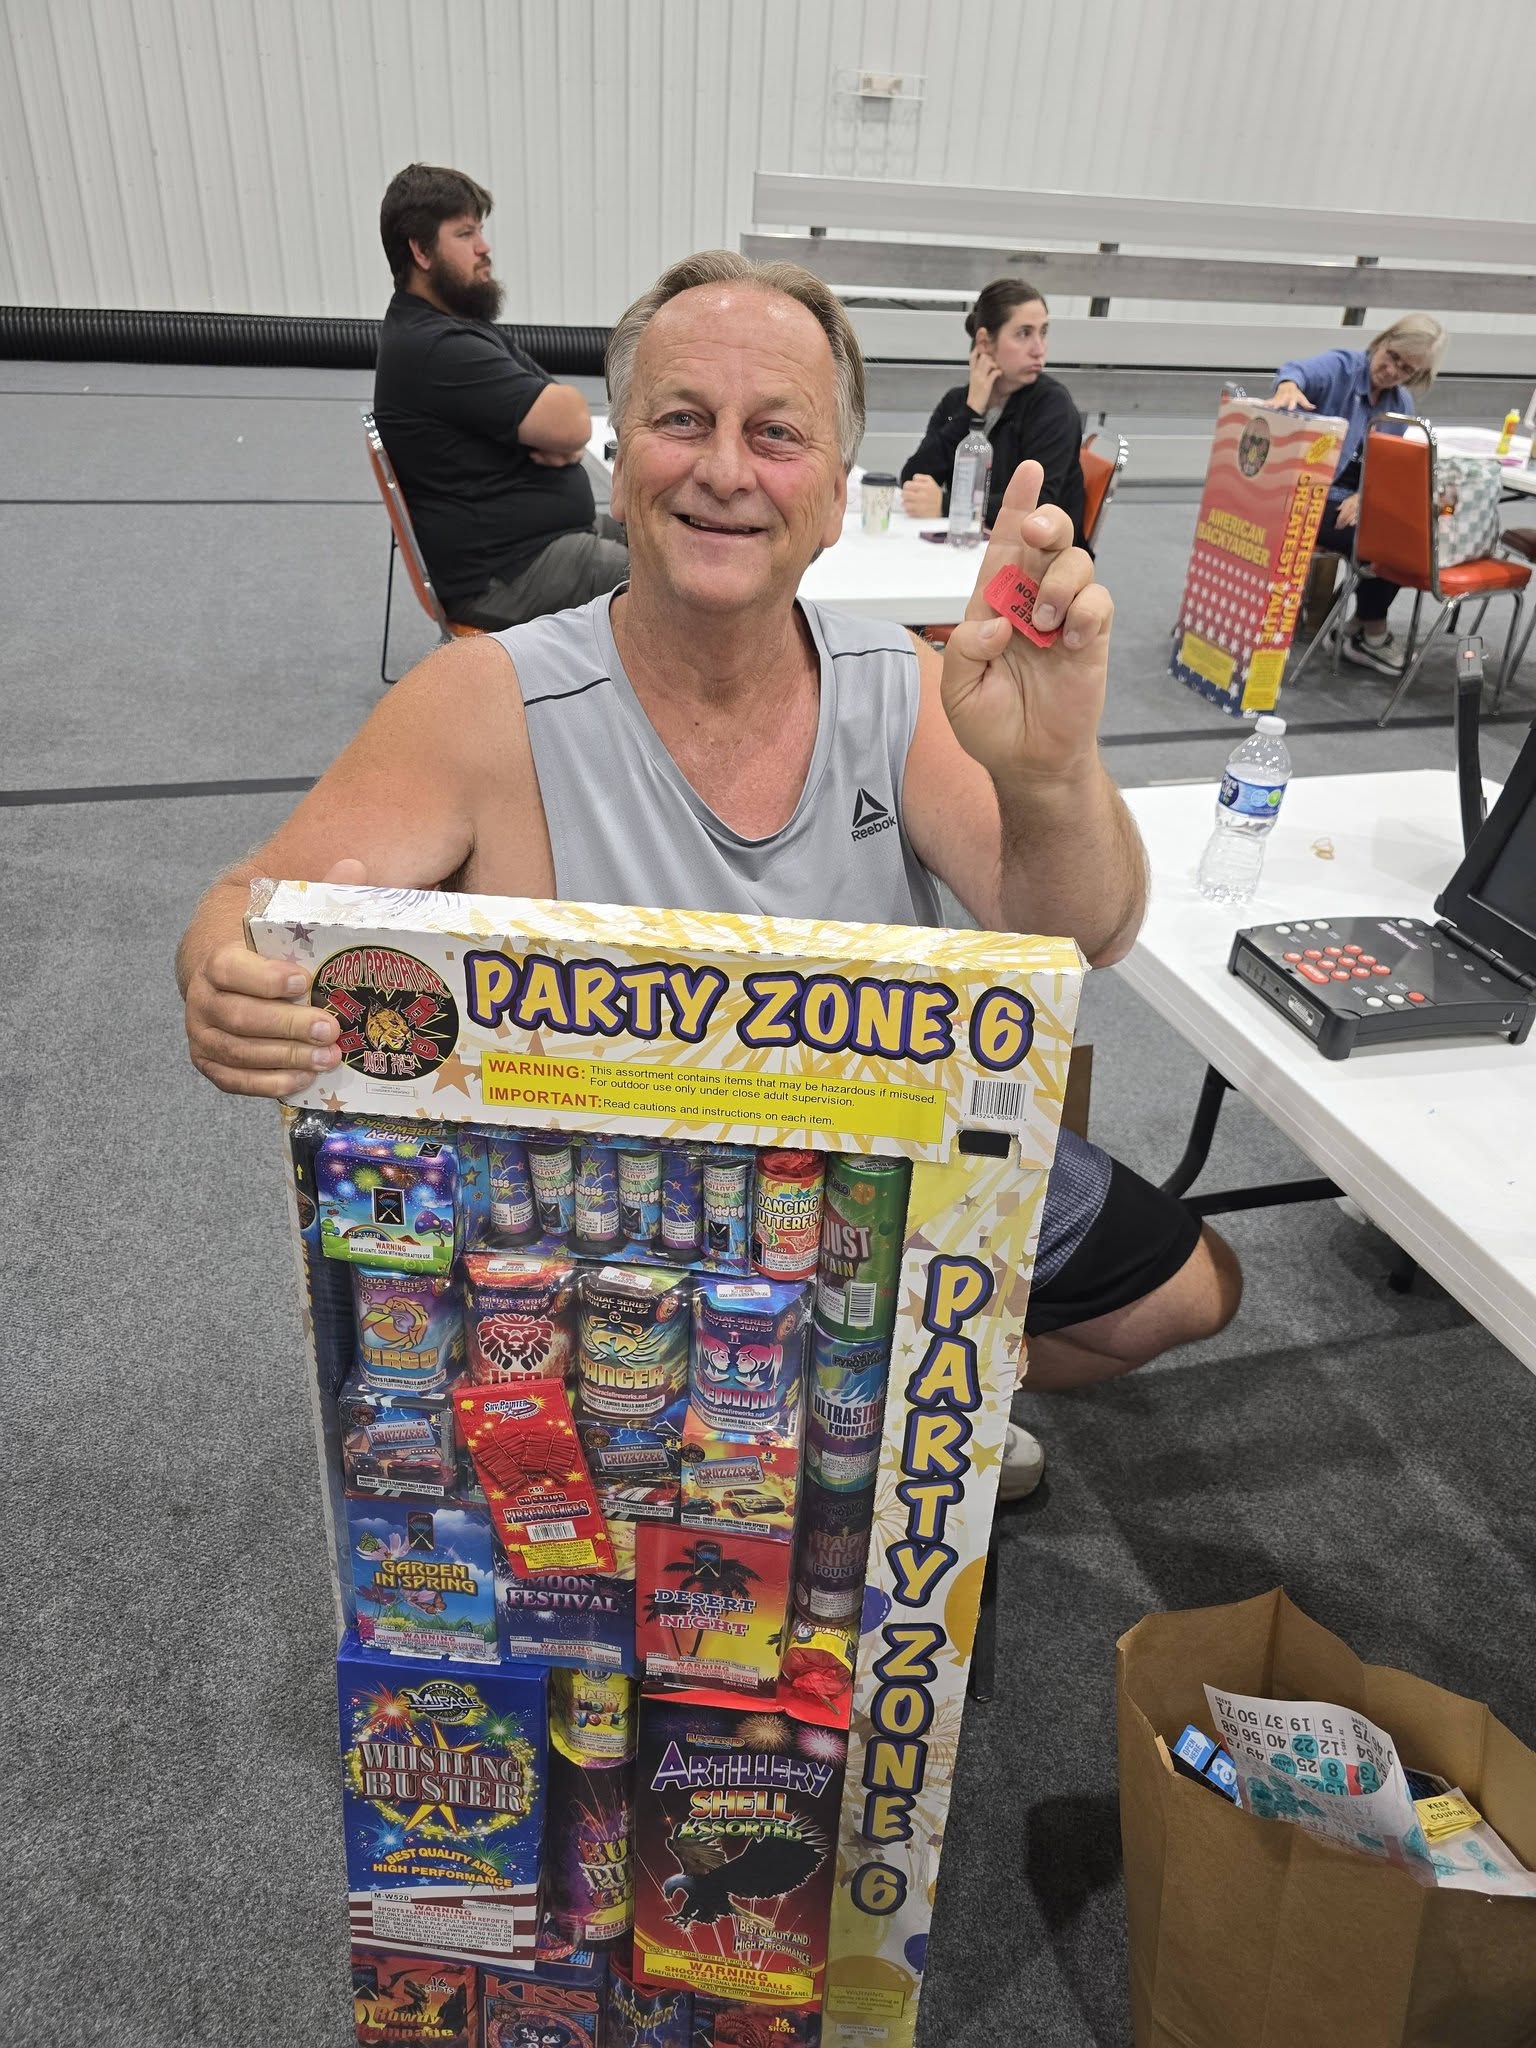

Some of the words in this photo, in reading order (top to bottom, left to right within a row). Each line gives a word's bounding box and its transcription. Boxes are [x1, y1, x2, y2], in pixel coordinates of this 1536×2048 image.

[1207, 508, 1266, 545] AMERICAN
[1275, 472, 1312, 577] GREATEST
[1292, 483, 1325, 584] GREATEST
[1198, 522, 1271, 568] BACKYARDER
[1261, 582, 1286, 644] VALUE
[1280, 588, 1302, 634] FUN
[851, 816, 897, 842] Reebok
[321, 951, 363, 987] PYRO
[364, 950, 451, 998] PREDATOR
[464, 950, 730, 1045] PARTY
[736, 971, 959, 1064] ZONE
[969, 986, 1035, 1071] 6
[488, 1059, 586, 1080] WARNING:
[590, 1065, 612, 1077] This
[616, 1067, 674, 1081] assortment
[677, 1072, 720, 1084] contains
[724, 1075, 753, 1087] items
[756, 1076, 777, 1088] that
[779, 1080, 802, 1092] may
[805, 1080, 818, 1092] be
[821, 1082, 876, 1097] hazardous
[879, 1087, 887, 1097] if
[889, 1089, 937, 1104] misused.
[590, 1077, 608, 1088] For
[611, 1078, 650, 1090] outdoor
[653, 1083, 672, 1093] use
[675, 1083, 697, 1096] only
[700, 1085, 729, 1097] under
[732, 1088, 760, 1099] close
[763, 1088, 789, 1101] adult
[792, 1091, 855, 1107] supervision.
[489, 1086, 602, 1109] IMPORTANT:
[603, 1098, 630, 1110] Read
[633, 1100, 676, 1114] cautions
[680, 1104, 699, 1116] and
[702, 1105, 762, 1120] instructions
[765, 1111, 779, 1121] on
[781, 1111, 807, 1124] each
[809, 1113, 835, 1126] item.
[354, 1118, 443, 1136] FIREWORKS
[365, 1129, 418, 1144] HAPPY
[757, 1191, 820, 1215] DANCING
[376, 1241, 407, 1252] WARNING
[391, 1279, 428, 1288] SERIES
[617, 1297, 652, 1308] SERIES
[618, 1306, 635, 1314] JUL
[737, 1316, 773, 1327] SERIES
[739, 1323, 759, 1332] JUN
[579, 1353, 665, 1390] CANCER
[500, 1400, 529, 1412] PAINTER
[885, 1254, 995, 1608] PARTY
[765, 1452, 772, 1460] 9
[534, 1493, 566, 1504] STRIPS
[504, 1502, 591, 1523] FIRECRACKERS
[381, 1560, 468, 1579] GARDEN
[374, 1571, 397, 1588] IN
[401, 1574, 478, 1597] SPRING
[526, 1575, 597, 1594] MOON
[508, 1588, 620, 1614] FESTIVAL
[655, 1588, 757, 1614] DESERT
[688, 1605, 725, 1619] AT
[660, 1613, 750, 1637] NIGHT
[403, 1632, 456, 1643] WARNING
[540, 1642, 593, 1652] WARNING
[676, 1660, 731, 1672] WARNING
[406, 1690, 484, 1712] MIRACLE
[572, 1686, 625, 1702] HAPPY
[1217, 1702, 1235, 1719] 71
[1237, 1709, 1258, 1725] 50
[1265, 1714, 1284, 1729] 37
[1290, 1717, 1311, 1732] 19
[1321, 1719, 1333, 1734] 5
[862, 1622, 947, 1846] ZONE
[1221, 1719, 1239, 1736] 68
[1241, 1728, 1261, 1745] 56
[1266, 1733, 1287, 1749] 40
[1292, 1738, 1314, 1754] 22
[1319, 1739, 1341, 1756] 12
[1352, 1723, 1371, 1744] 75
[1182, 1736, 1197, 1757] OPEN
[1189, 1743, 1204, 1763] HERE
[1356, 1743, 1374, 1764] 64
[360, 1743, 523, 1784] WHISTLING
[650, 1741, 834, 1799] ARTILLERY
[1296, 1757, 1318, 1774] 25
[1327, 1763, 1339, 1778] 8
[363, 1770, 524, 1813] BUSTER
[688, 1790, 797, 1822] SHELL
[1427, 1800, 1450, 1810] KEEP
[1430, 1809, 1466, 1821] COUPON
[678, 1818, 803, 1842] ASSORTED
[386, 1848, 417, 1865] BEST
[419, 1847, 471, 1865] QUALITY
[471, 1860, 499, 1877] AND
[372, 1863, 408, 1875] HIGH
[411, 1866, 514, 1888] PERFORMANCE
[374, 1892, 410, 1901] M-W520
[851, 1861, 908, 1916] 6
[378, 1906, 405, 1914] SHOOTS
[405, 1909, 436, 1917] FLAMING
[414, 1905, 472, 1916] WARNING
[738, 1919, 759, 1934] BEST
[759, 1924, 790, 1941] QUALITY
[791, 1930, 811, 1945] AND
[683, 1951, 715, 1961] CONSUMER
[715, 1955, 752, 1966] FIREWORKS
[734, 1938, 757, 1953] HIGH
[757, 1938, 812, 1966] PERFORMANCE
[431, 1976, 447, 1988] 16
[646, 1967, 680, 1979] CAREFULLY
[679, 1973, 696, 1981] READ
[695, 1975, 730, 1987] ADDITIONAL
[729, 1981, 760, 1992] WARNING
[769, 1988, 791, 1996] OTHER
[664, 1965, 708, 1979] SHOOTS
[708, 1972, 757, 1986] FLAMING
[758, 1981, 793, 1991] BALLS
[688, 1960, 769, 1982] WARNING
[425, 1984, 455, 1994] SHOTS
[484, 1974, 600, 2012] KISS
[699, 1984, 719, 1993] MADE
[728, 1989, 749, 1997] CHINA
[373, 2005, 444, 2025] Rowdy
[774, 2016, 789, 2027] 16
[768, 2024, 796, 2034] SHOTS
